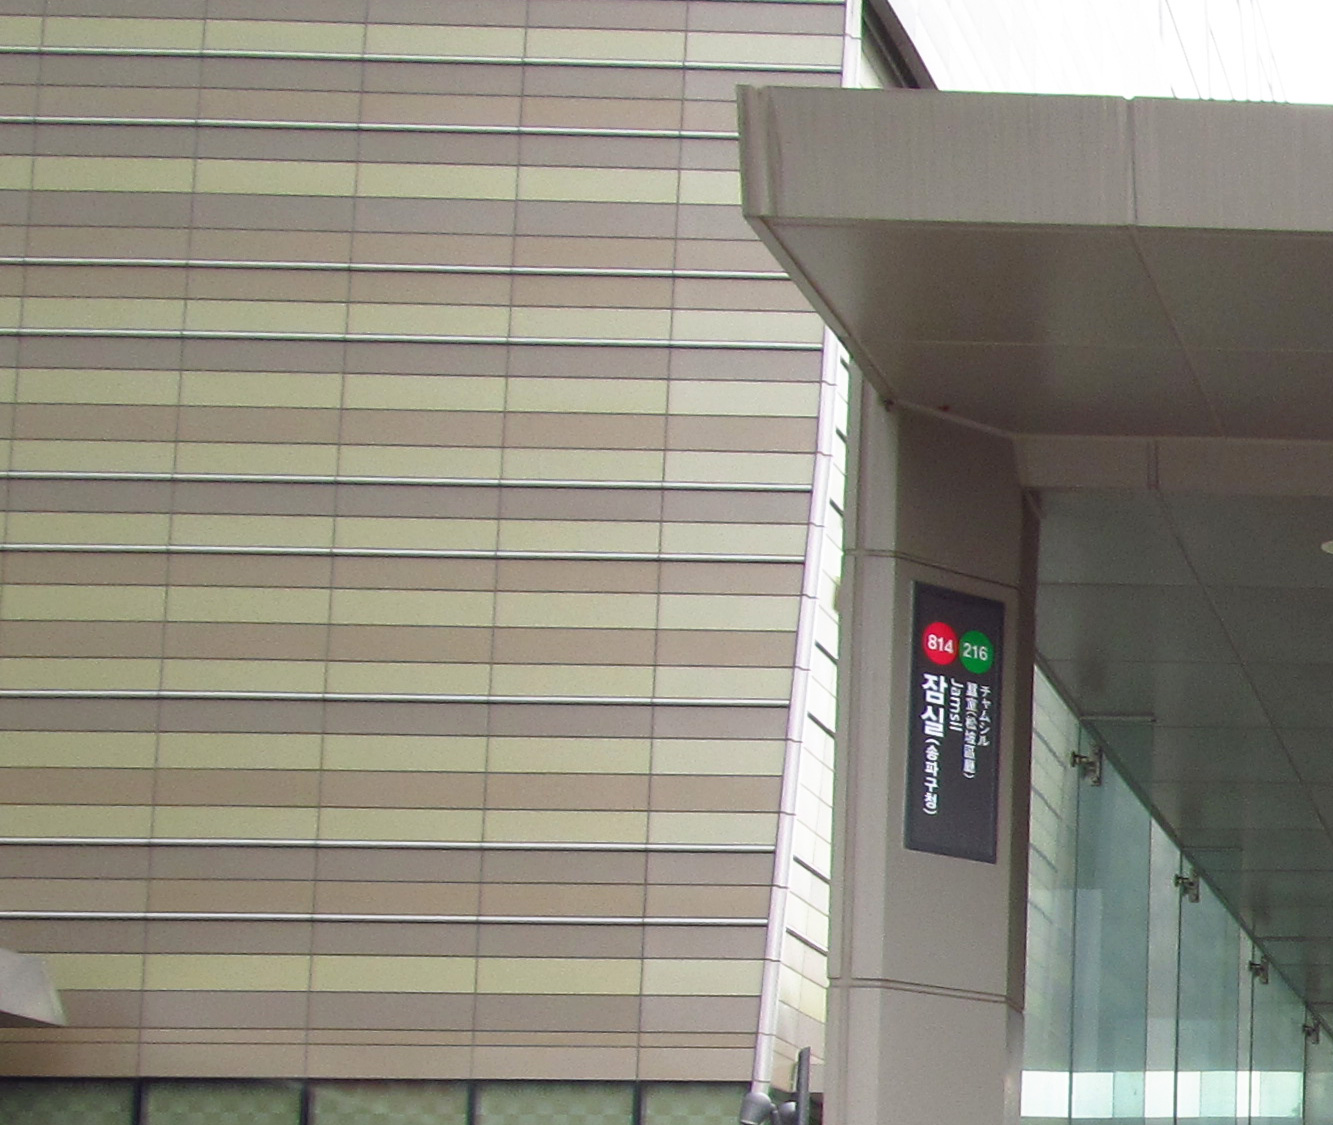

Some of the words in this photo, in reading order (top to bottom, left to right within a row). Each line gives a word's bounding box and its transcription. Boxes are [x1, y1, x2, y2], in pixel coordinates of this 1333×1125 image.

[927, 634, 954, 654] 814
[963, 642, 988, 662] 216
[949, 678, 963, 732] Jamsil
[977, 685, 992, 747] チャムシル
